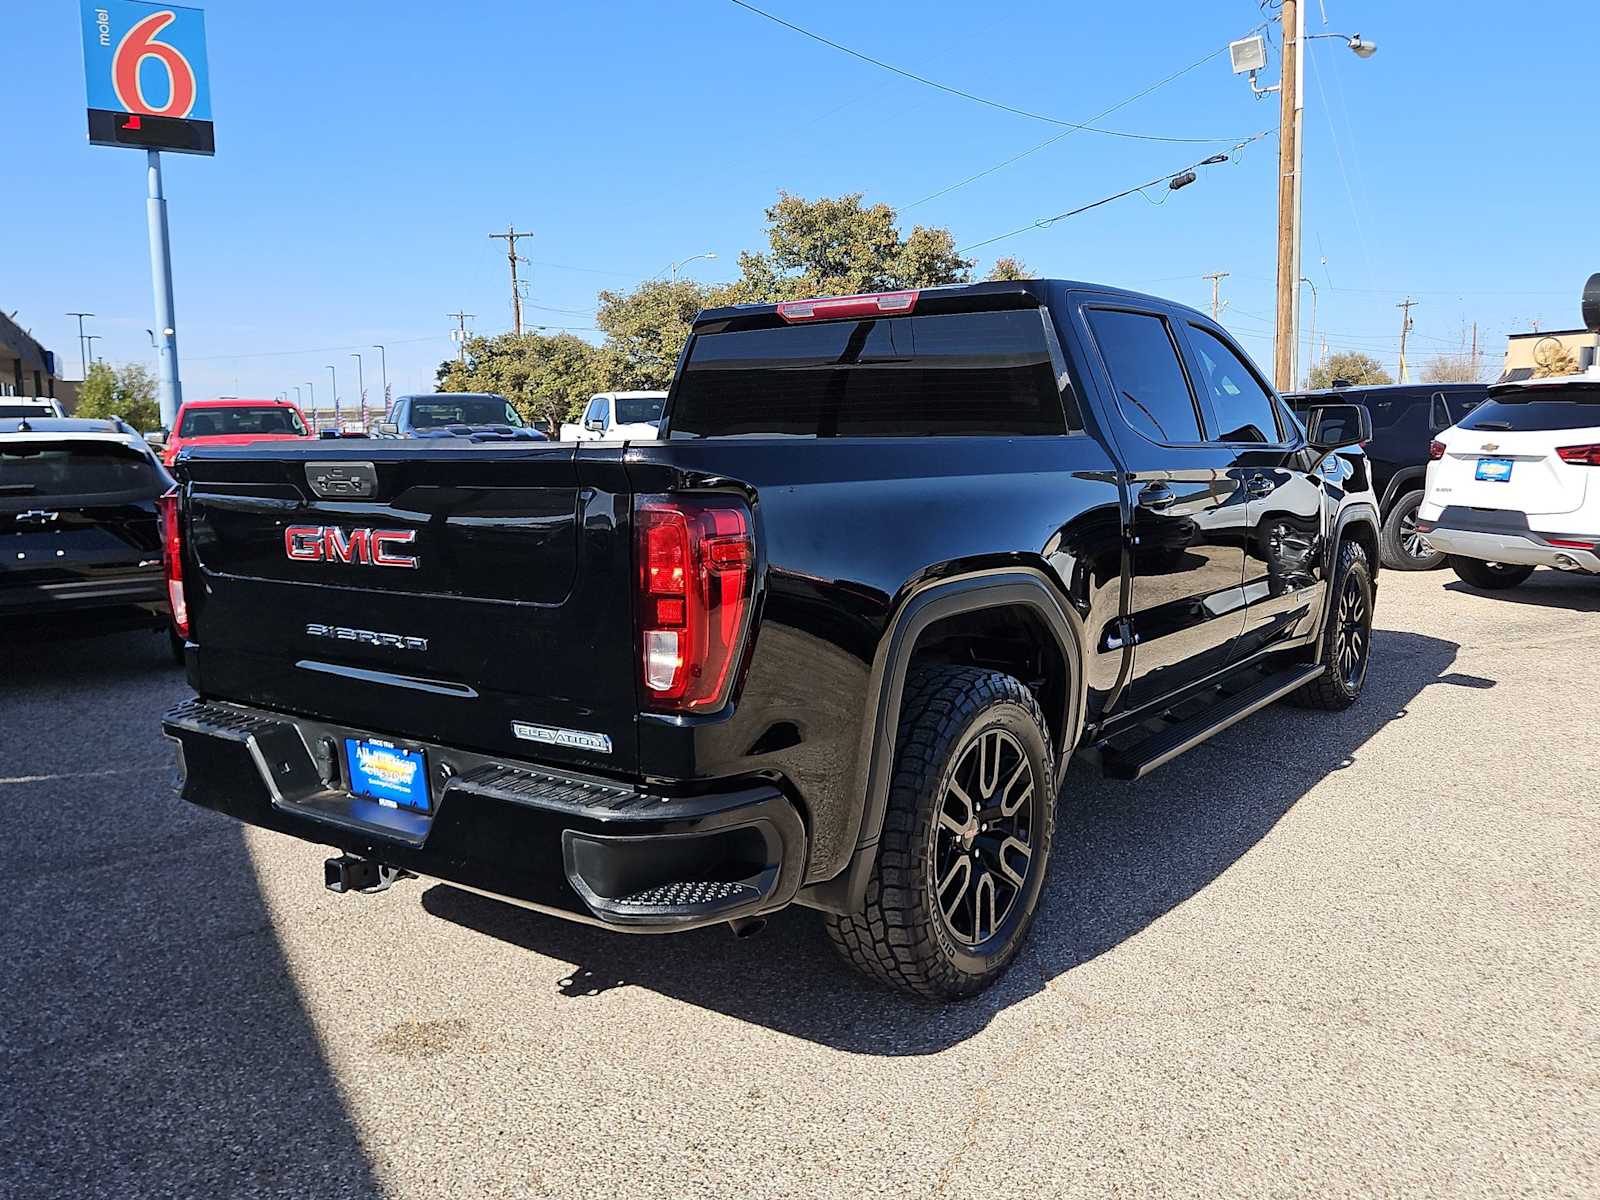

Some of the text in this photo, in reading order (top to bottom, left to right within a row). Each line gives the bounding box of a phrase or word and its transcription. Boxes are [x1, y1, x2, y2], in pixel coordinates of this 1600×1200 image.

[95, 9, 111, 46] motel
[111, 10, 197, 118] 6
[285, 524, 421, 570] GMC
[306, 623, 429, 651] SIERRA
[516, 726, 606, 749] ELEVATION
